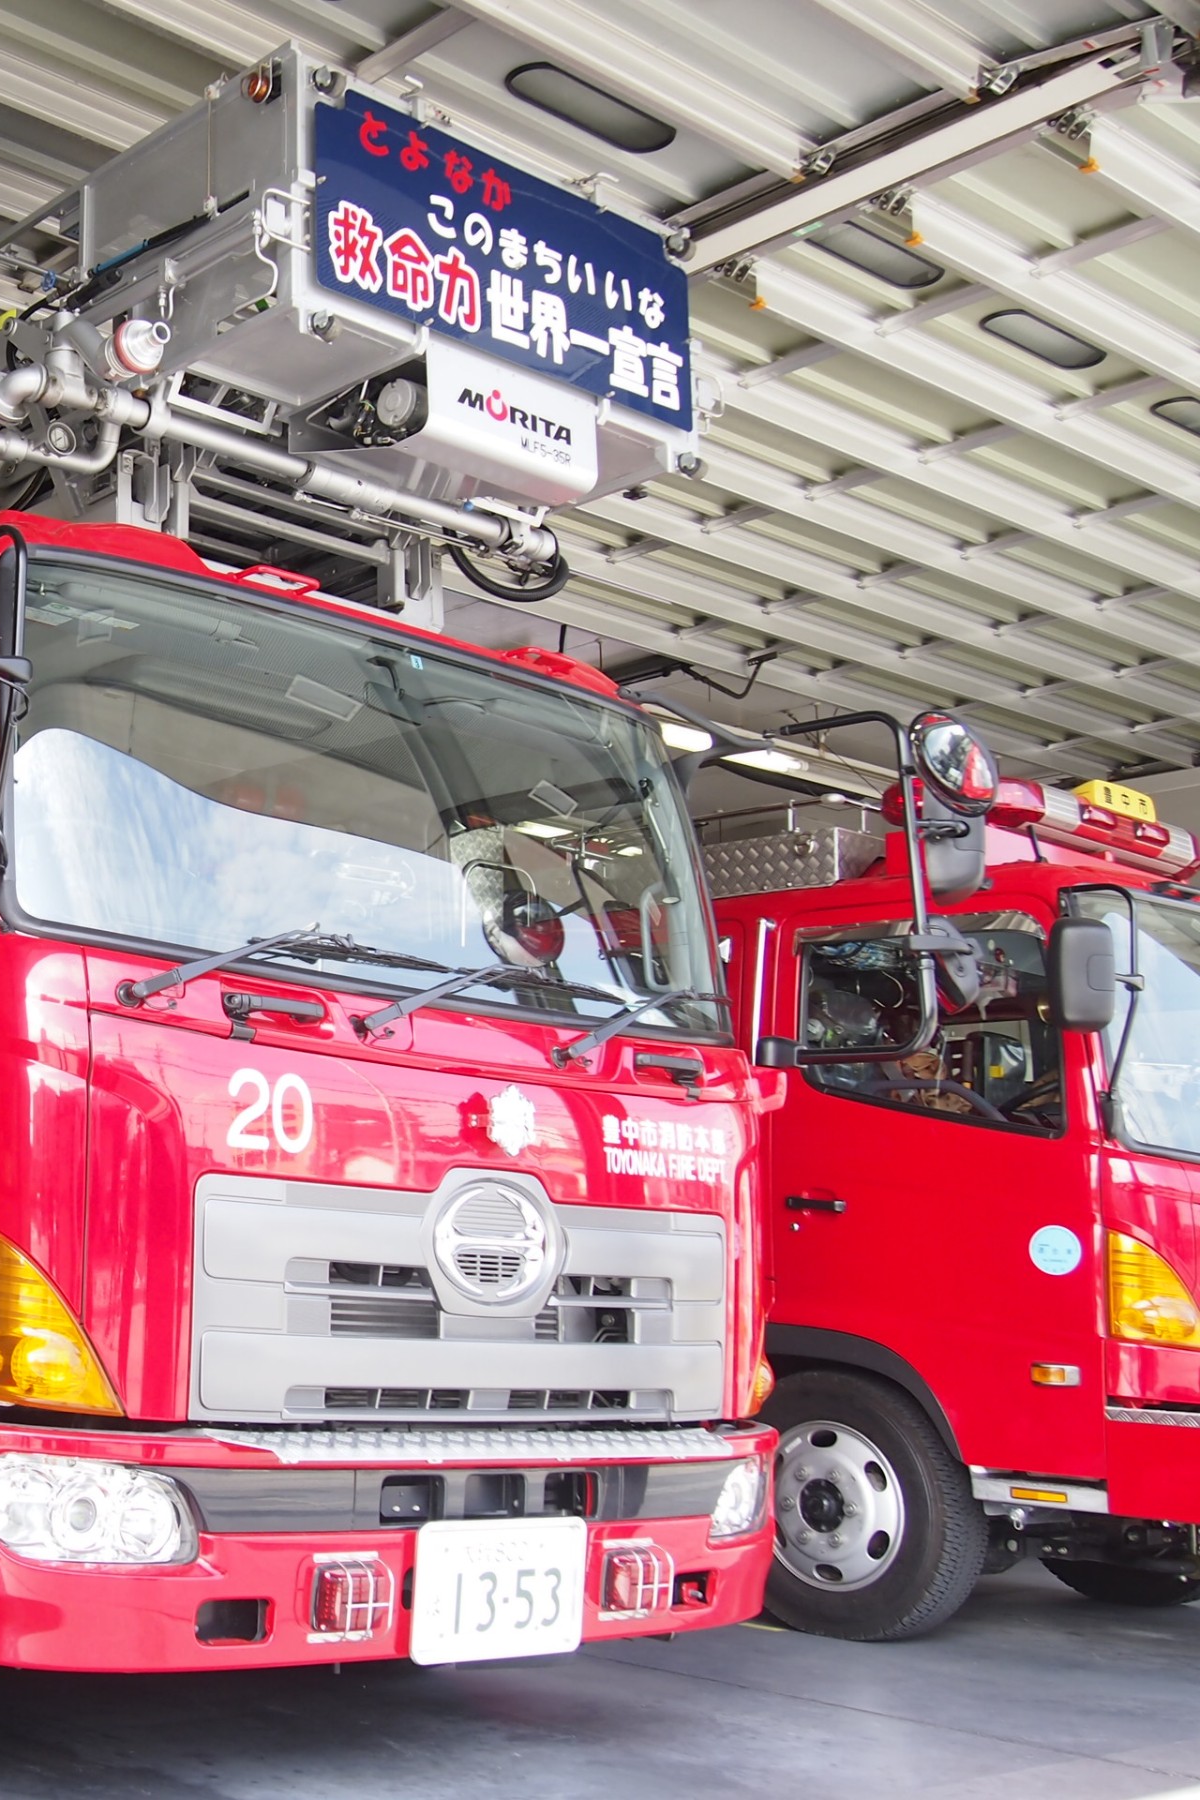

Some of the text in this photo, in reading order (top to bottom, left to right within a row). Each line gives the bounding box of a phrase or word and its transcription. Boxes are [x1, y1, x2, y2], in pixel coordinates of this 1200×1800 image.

[359, 110, 511, 211] とよなか
[328, 200, 684, 411] 救命力世界一宣言
[427, 194, 666, 329] このまちいいな
[457, 388, 572, 446] MORITA
[226, 1068, 314, 1154] 20
[603, 1146, 668, 1178] TOYONAKA
[669, 1153, 697, 1181] FIRE
